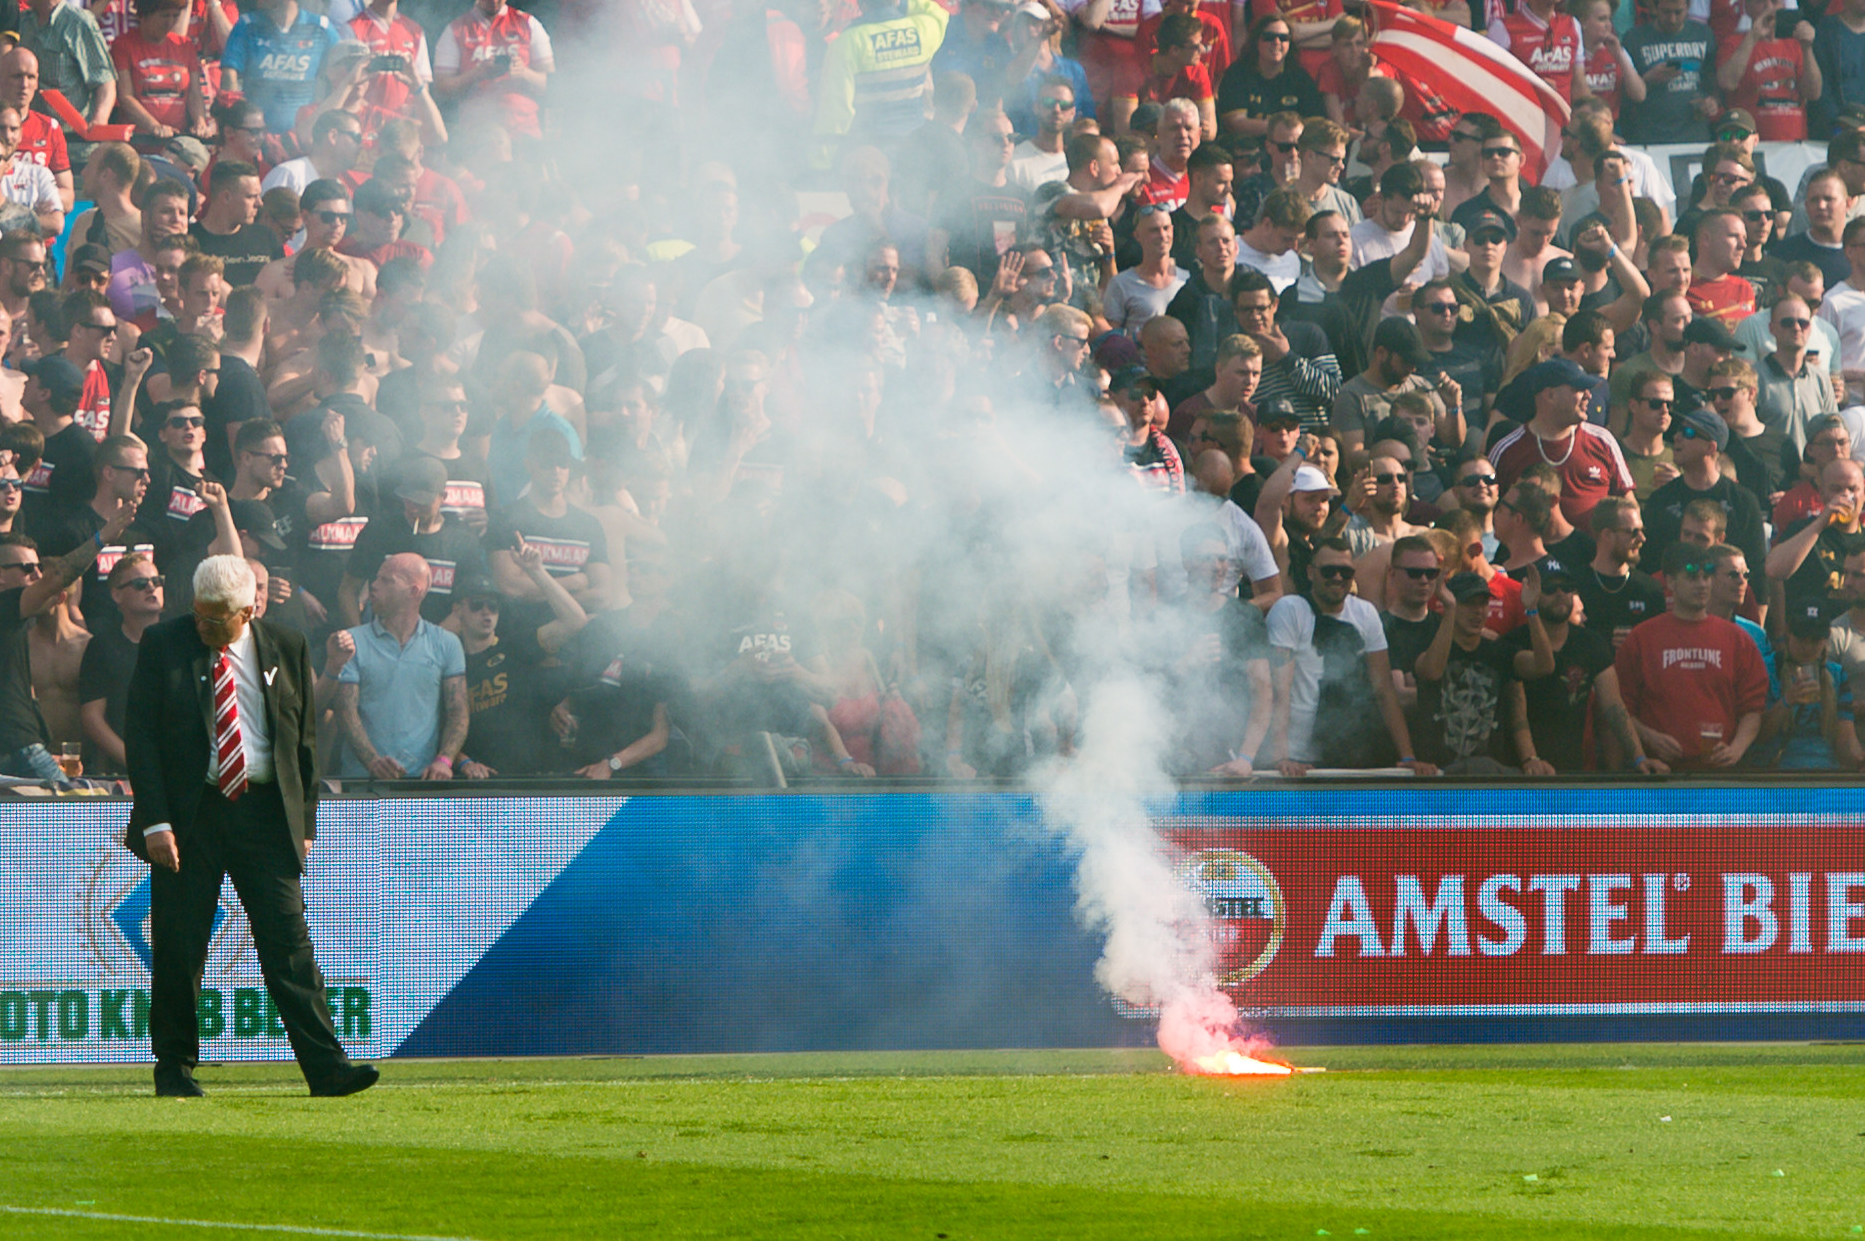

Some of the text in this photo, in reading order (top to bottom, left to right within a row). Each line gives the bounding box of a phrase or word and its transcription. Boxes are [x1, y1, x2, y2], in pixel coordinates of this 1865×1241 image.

[874, 29, 918, 49] AFAS
[259, 54, 310, 71] AFAS
[1642, 42, 1707, 64] SUPERDRY
[737, 632, 793, 655] AFAS
[1662, 648, 1722, 669] FRONTLINE
[469, 672, 509, 701] FAS
[1315, 872, 1691, 957] AMSTEL
[100, 987, 224, 1040] KNB
